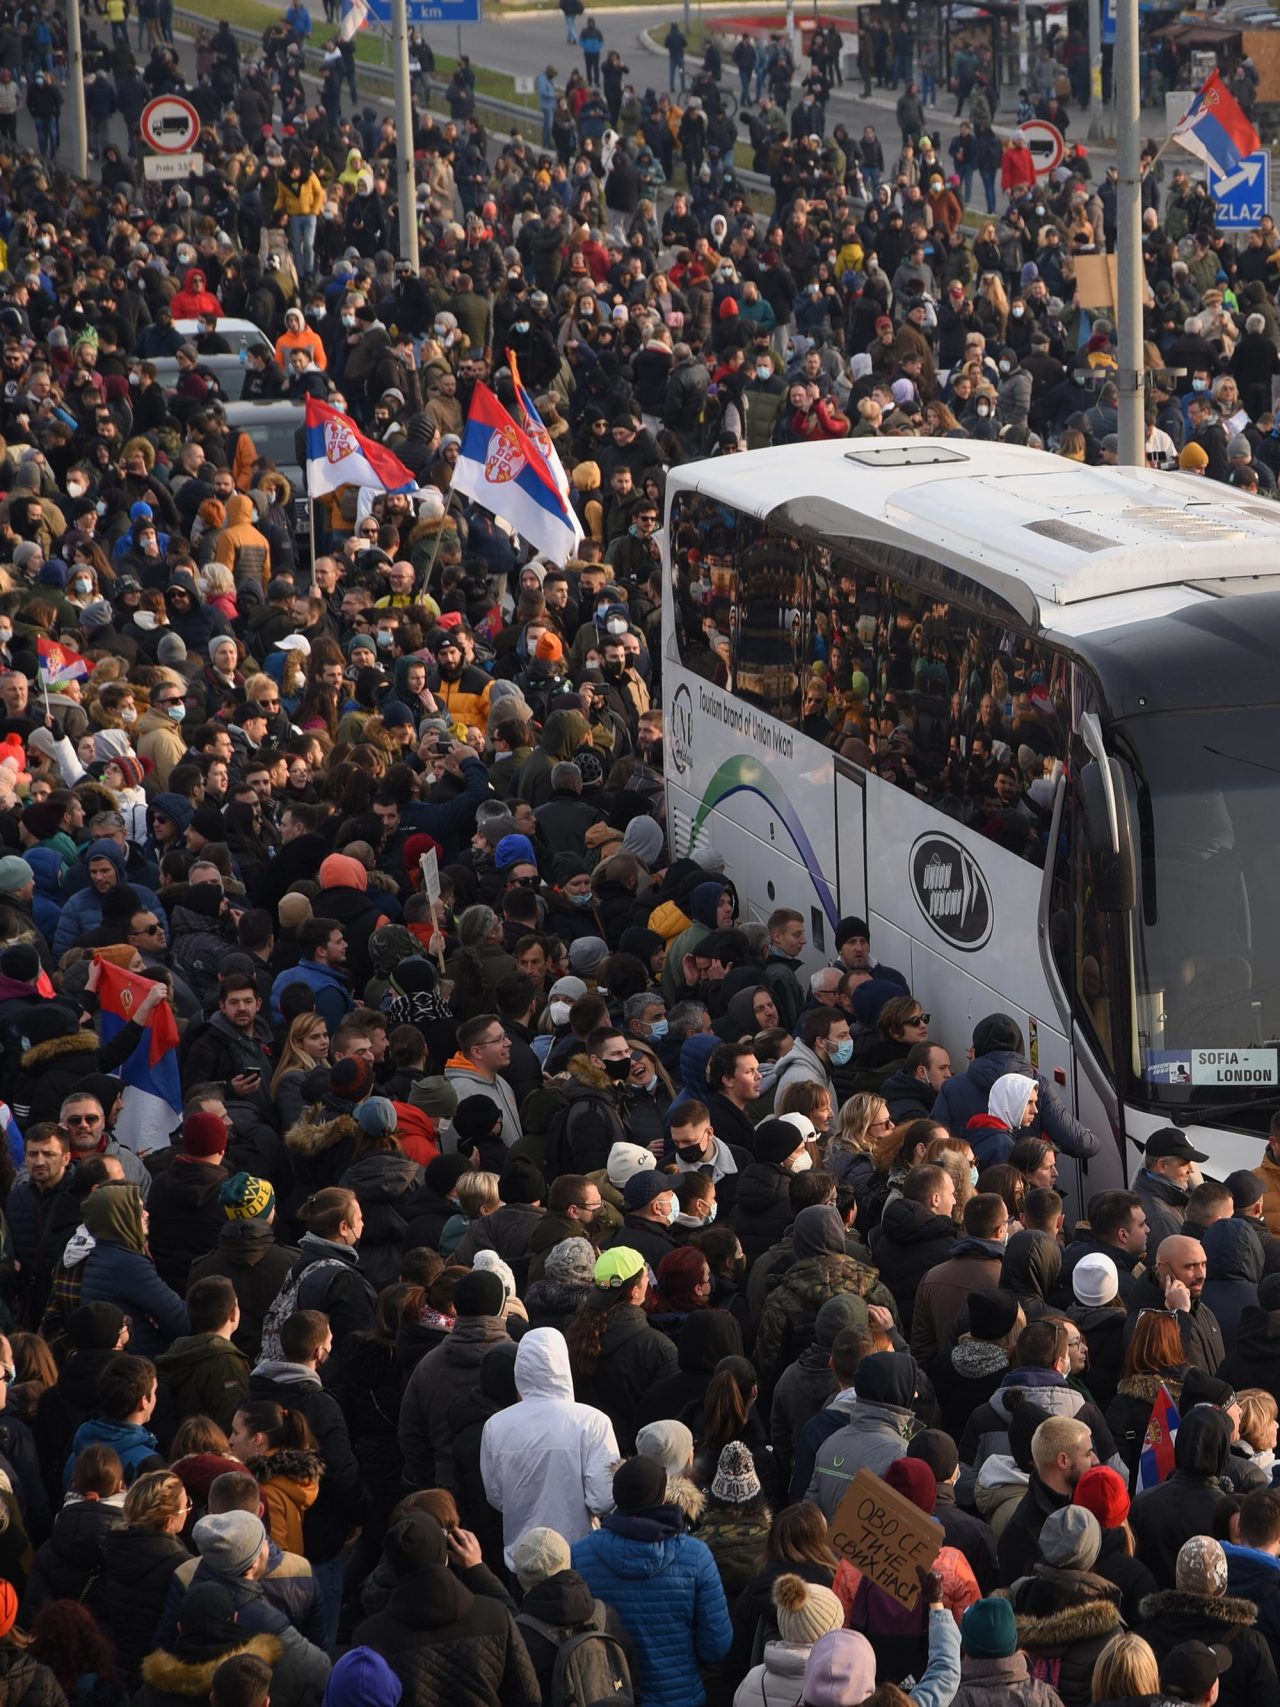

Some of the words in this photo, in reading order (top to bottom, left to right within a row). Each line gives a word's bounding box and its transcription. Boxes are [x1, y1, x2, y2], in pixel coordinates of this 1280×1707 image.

[421, 6, 442, 18] km
[1213, 203, 1262, 220] ZLAZ
[699, 686, 722, 720] Tourism
[724, 698, 743, 732] brand
[744, 712, 751, 737] of
[752, 715, 771, 747] Union
[772, 725, 794, 760] Ivkoni
[1199, 1052, 1239, 1065] SOFIA
[1216, 1069, 1272, 1082] LONDON
[857, 1498, 899, 1536] ОВО
[898, 1533, 928, 1559] СЕ
[833, 1532, 879, 1576] СВИХ
[860, 1525, 908, 1572] ТИЧЕ
